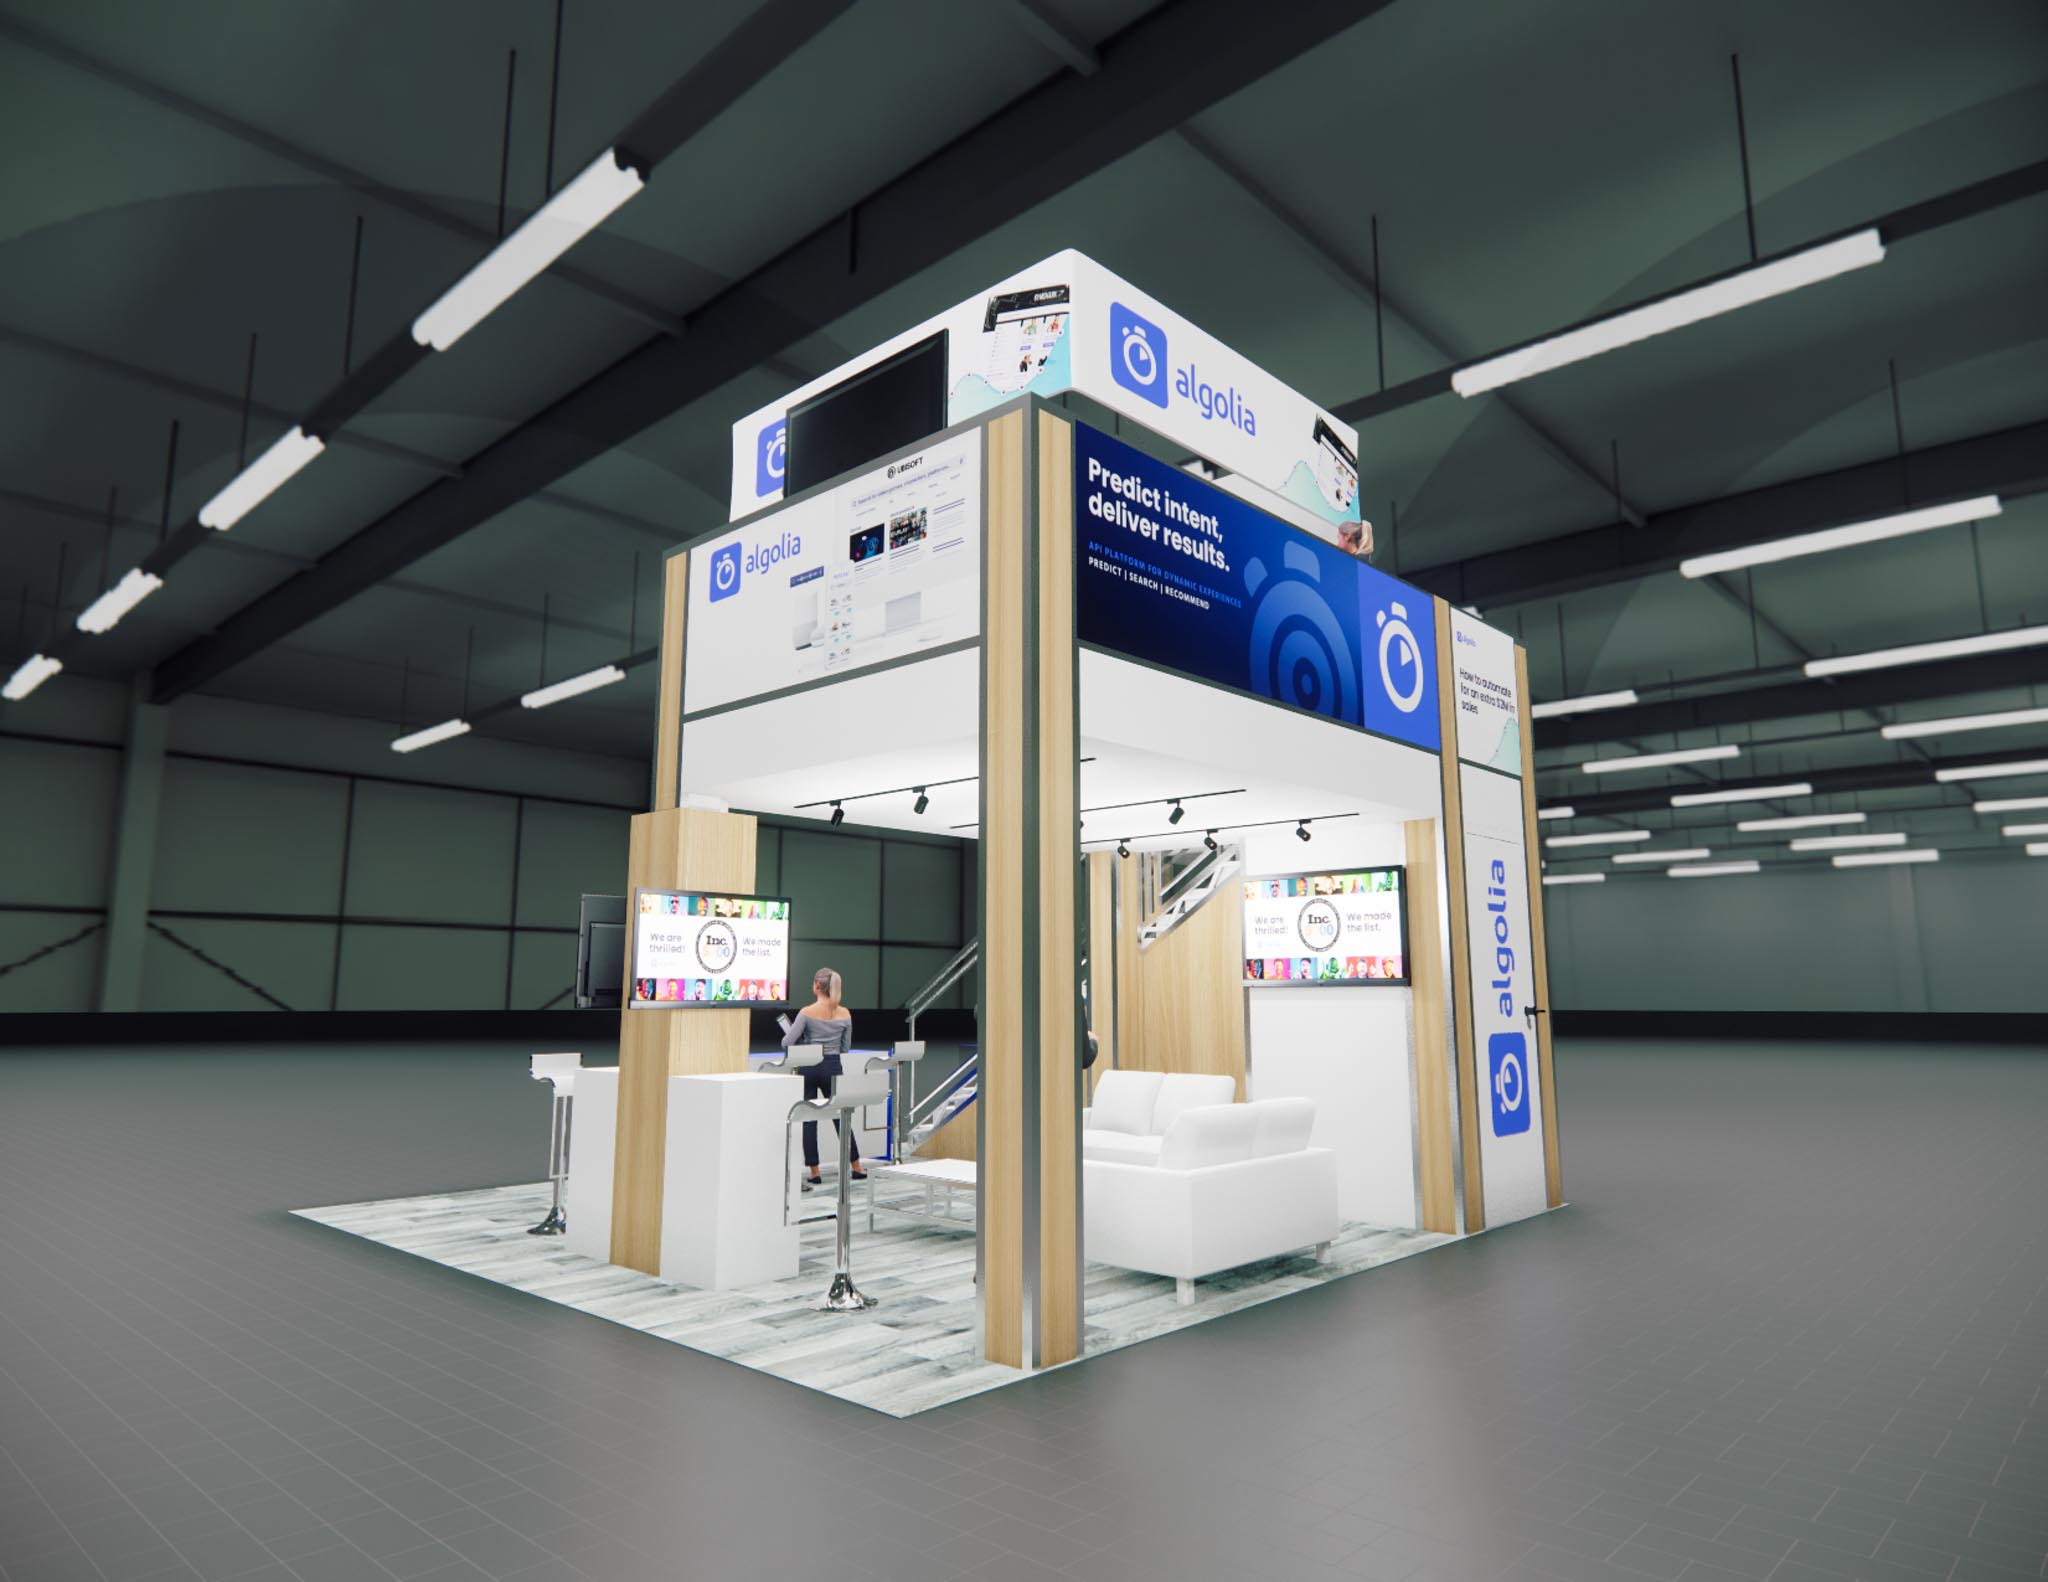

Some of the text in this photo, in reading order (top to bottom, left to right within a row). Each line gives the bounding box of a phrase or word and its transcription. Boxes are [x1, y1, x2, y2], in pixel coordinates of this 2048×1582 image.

[1176, 363, 1256, 437] algolia
[1089, 457, 1223, 543] Predict intent,
[745, 532, 801, 575] algolia
[1088, 491, 1230, 573] deliver results.
[1088, 556, 1122, 577] PREDICT
[1129, 572, 1158, 590] SEARCH
[1165, 585, 1210, 610] RECOMMEND
[1089, 541, 1103, 553] API
[1104, 546, 1146, 570] PLATFORM
[1148, 565, 1162, 577] FOR
[1164, 570, 1197, 591] DYNAMIC
[1459, 667, 1474, 682] How
[650, 932, 682, 942] We are
[1346, 911, 1392, 922] We made
[1346, 923, 1363, 932] the
[742, 936, 781, 946] We made
[742, 948, 756, 956] the
[1487, 859, 1515, 1018] algolia
